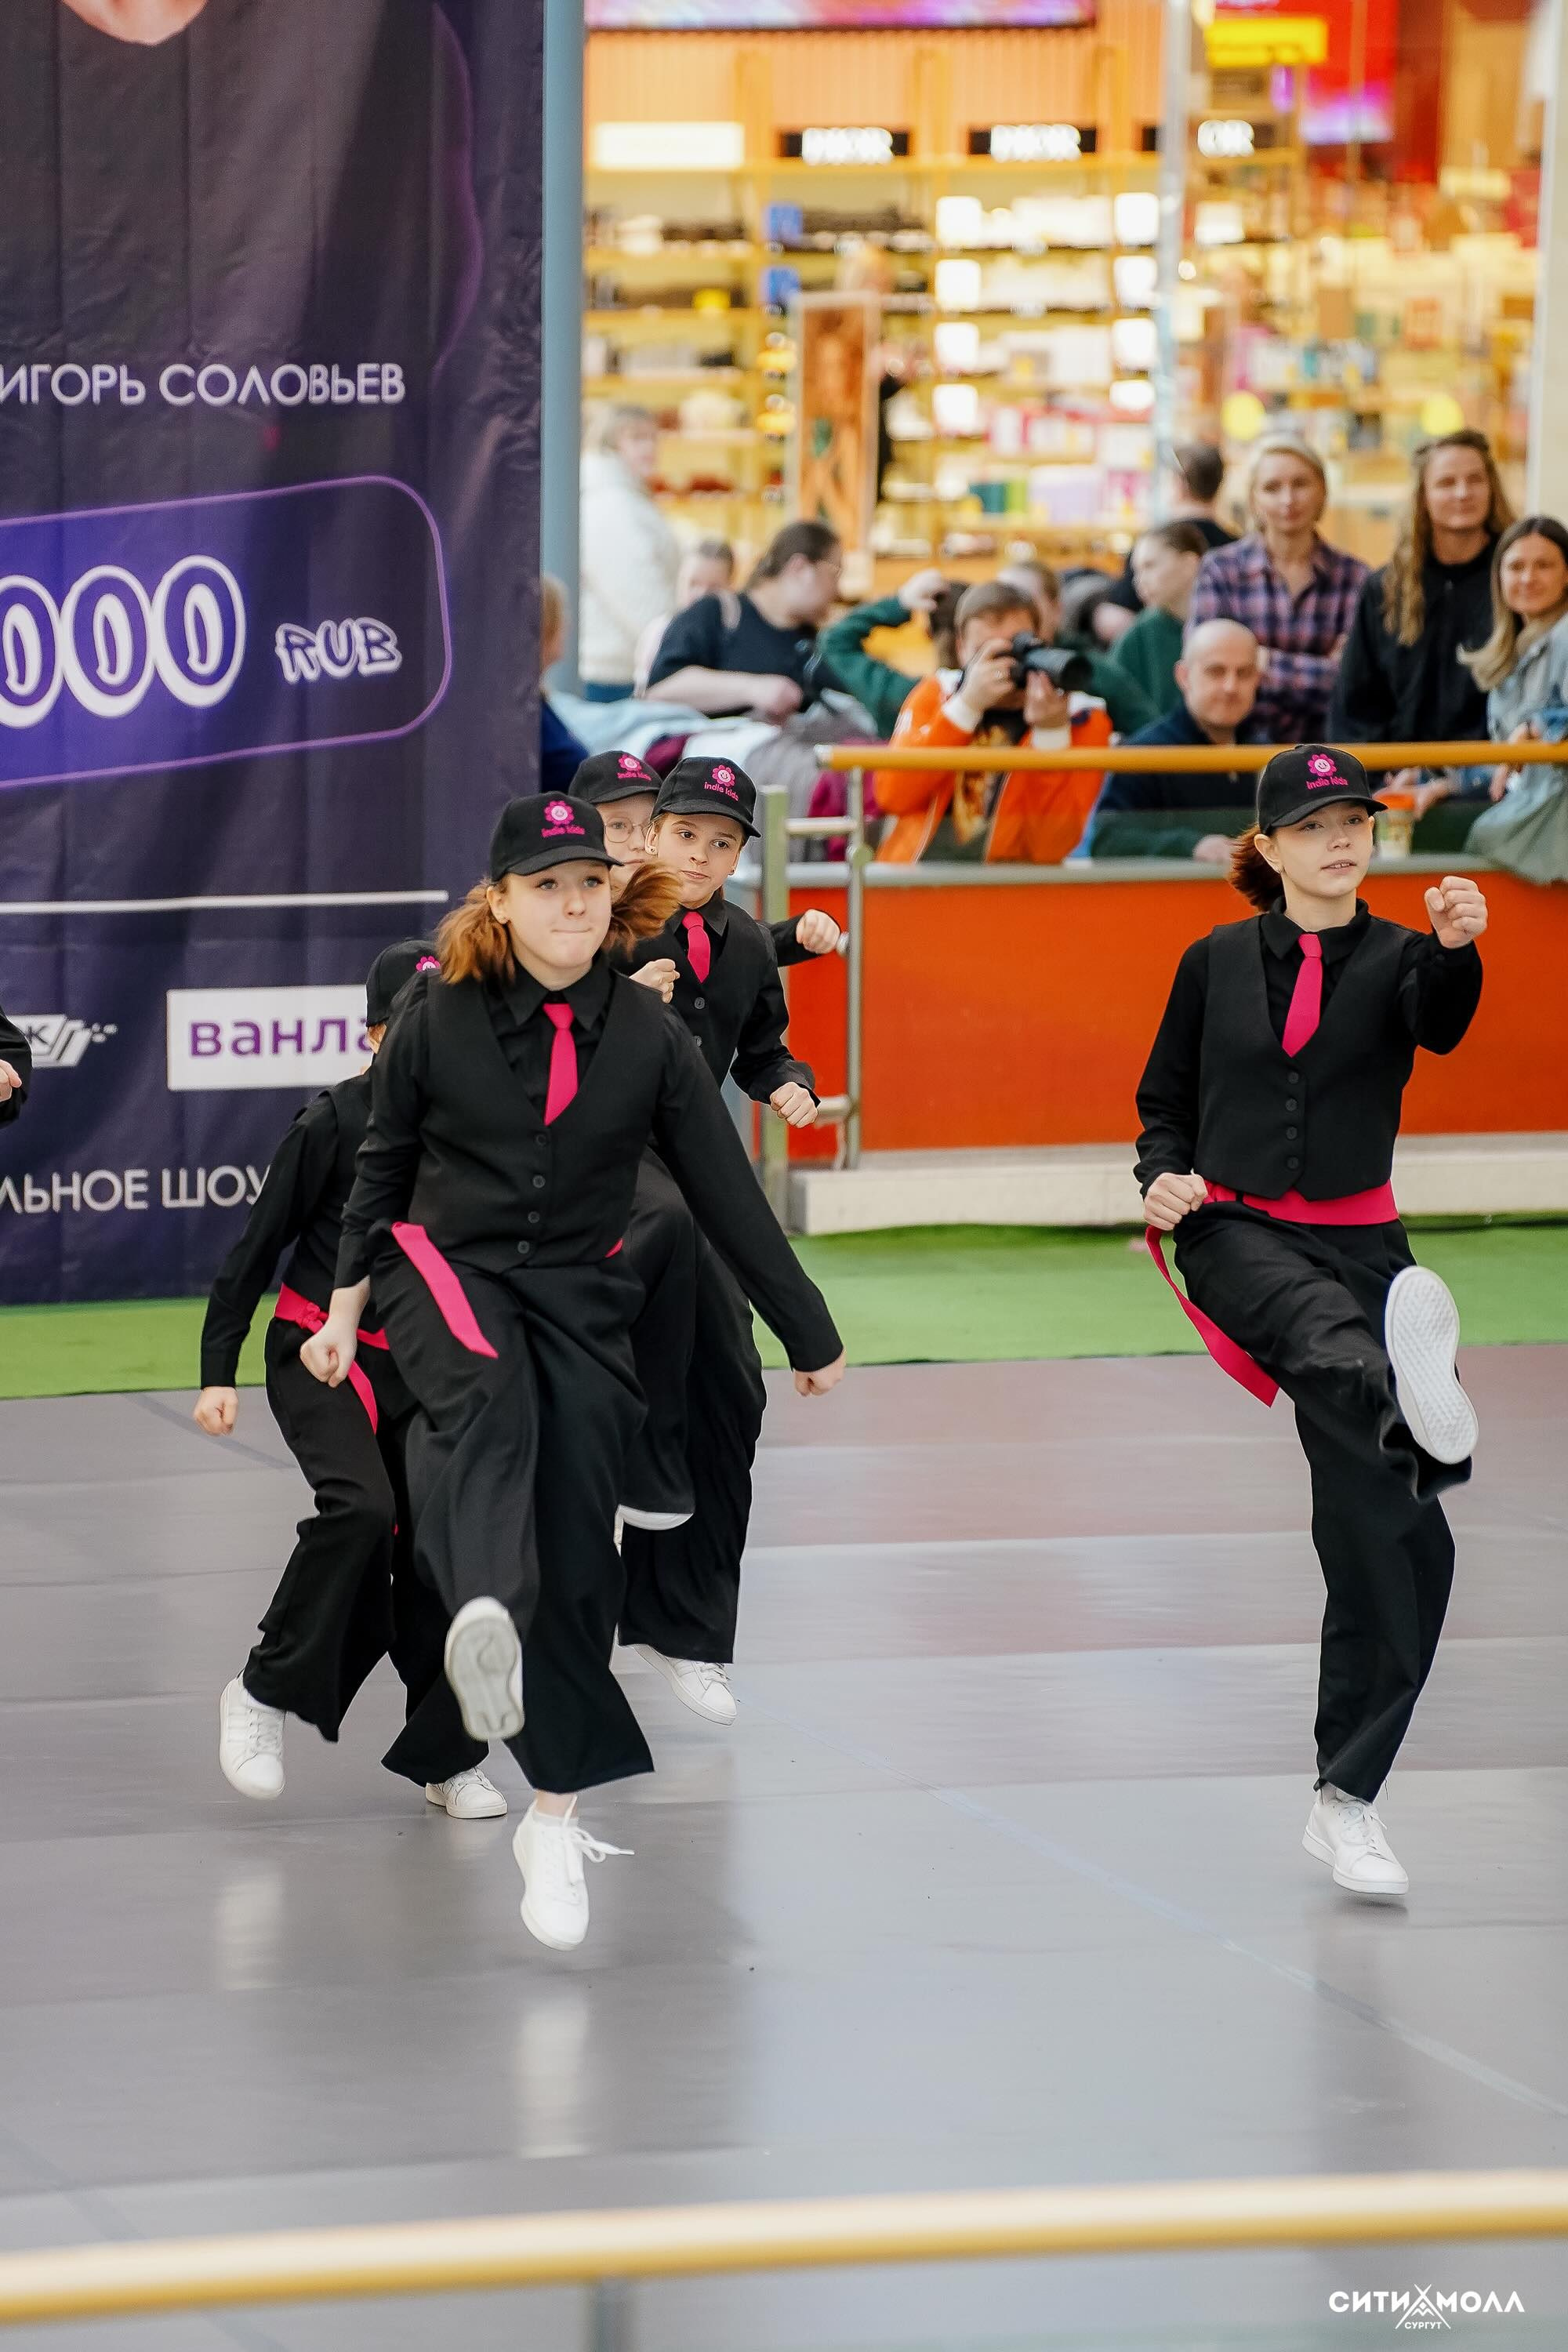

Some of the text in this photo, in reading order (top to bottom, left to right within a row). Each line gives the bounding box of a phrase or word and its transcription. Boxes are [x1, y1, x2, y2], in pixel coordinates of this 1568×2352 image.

[0, 363, 406, 405] ИГОРЬ СОЛОВЬЕВ
[274, 616, 402, 684] RUB
[704, 782, 724, 793] indie
[0, 1165, 270, 1214] ЛЬНОЕ ШОУ
